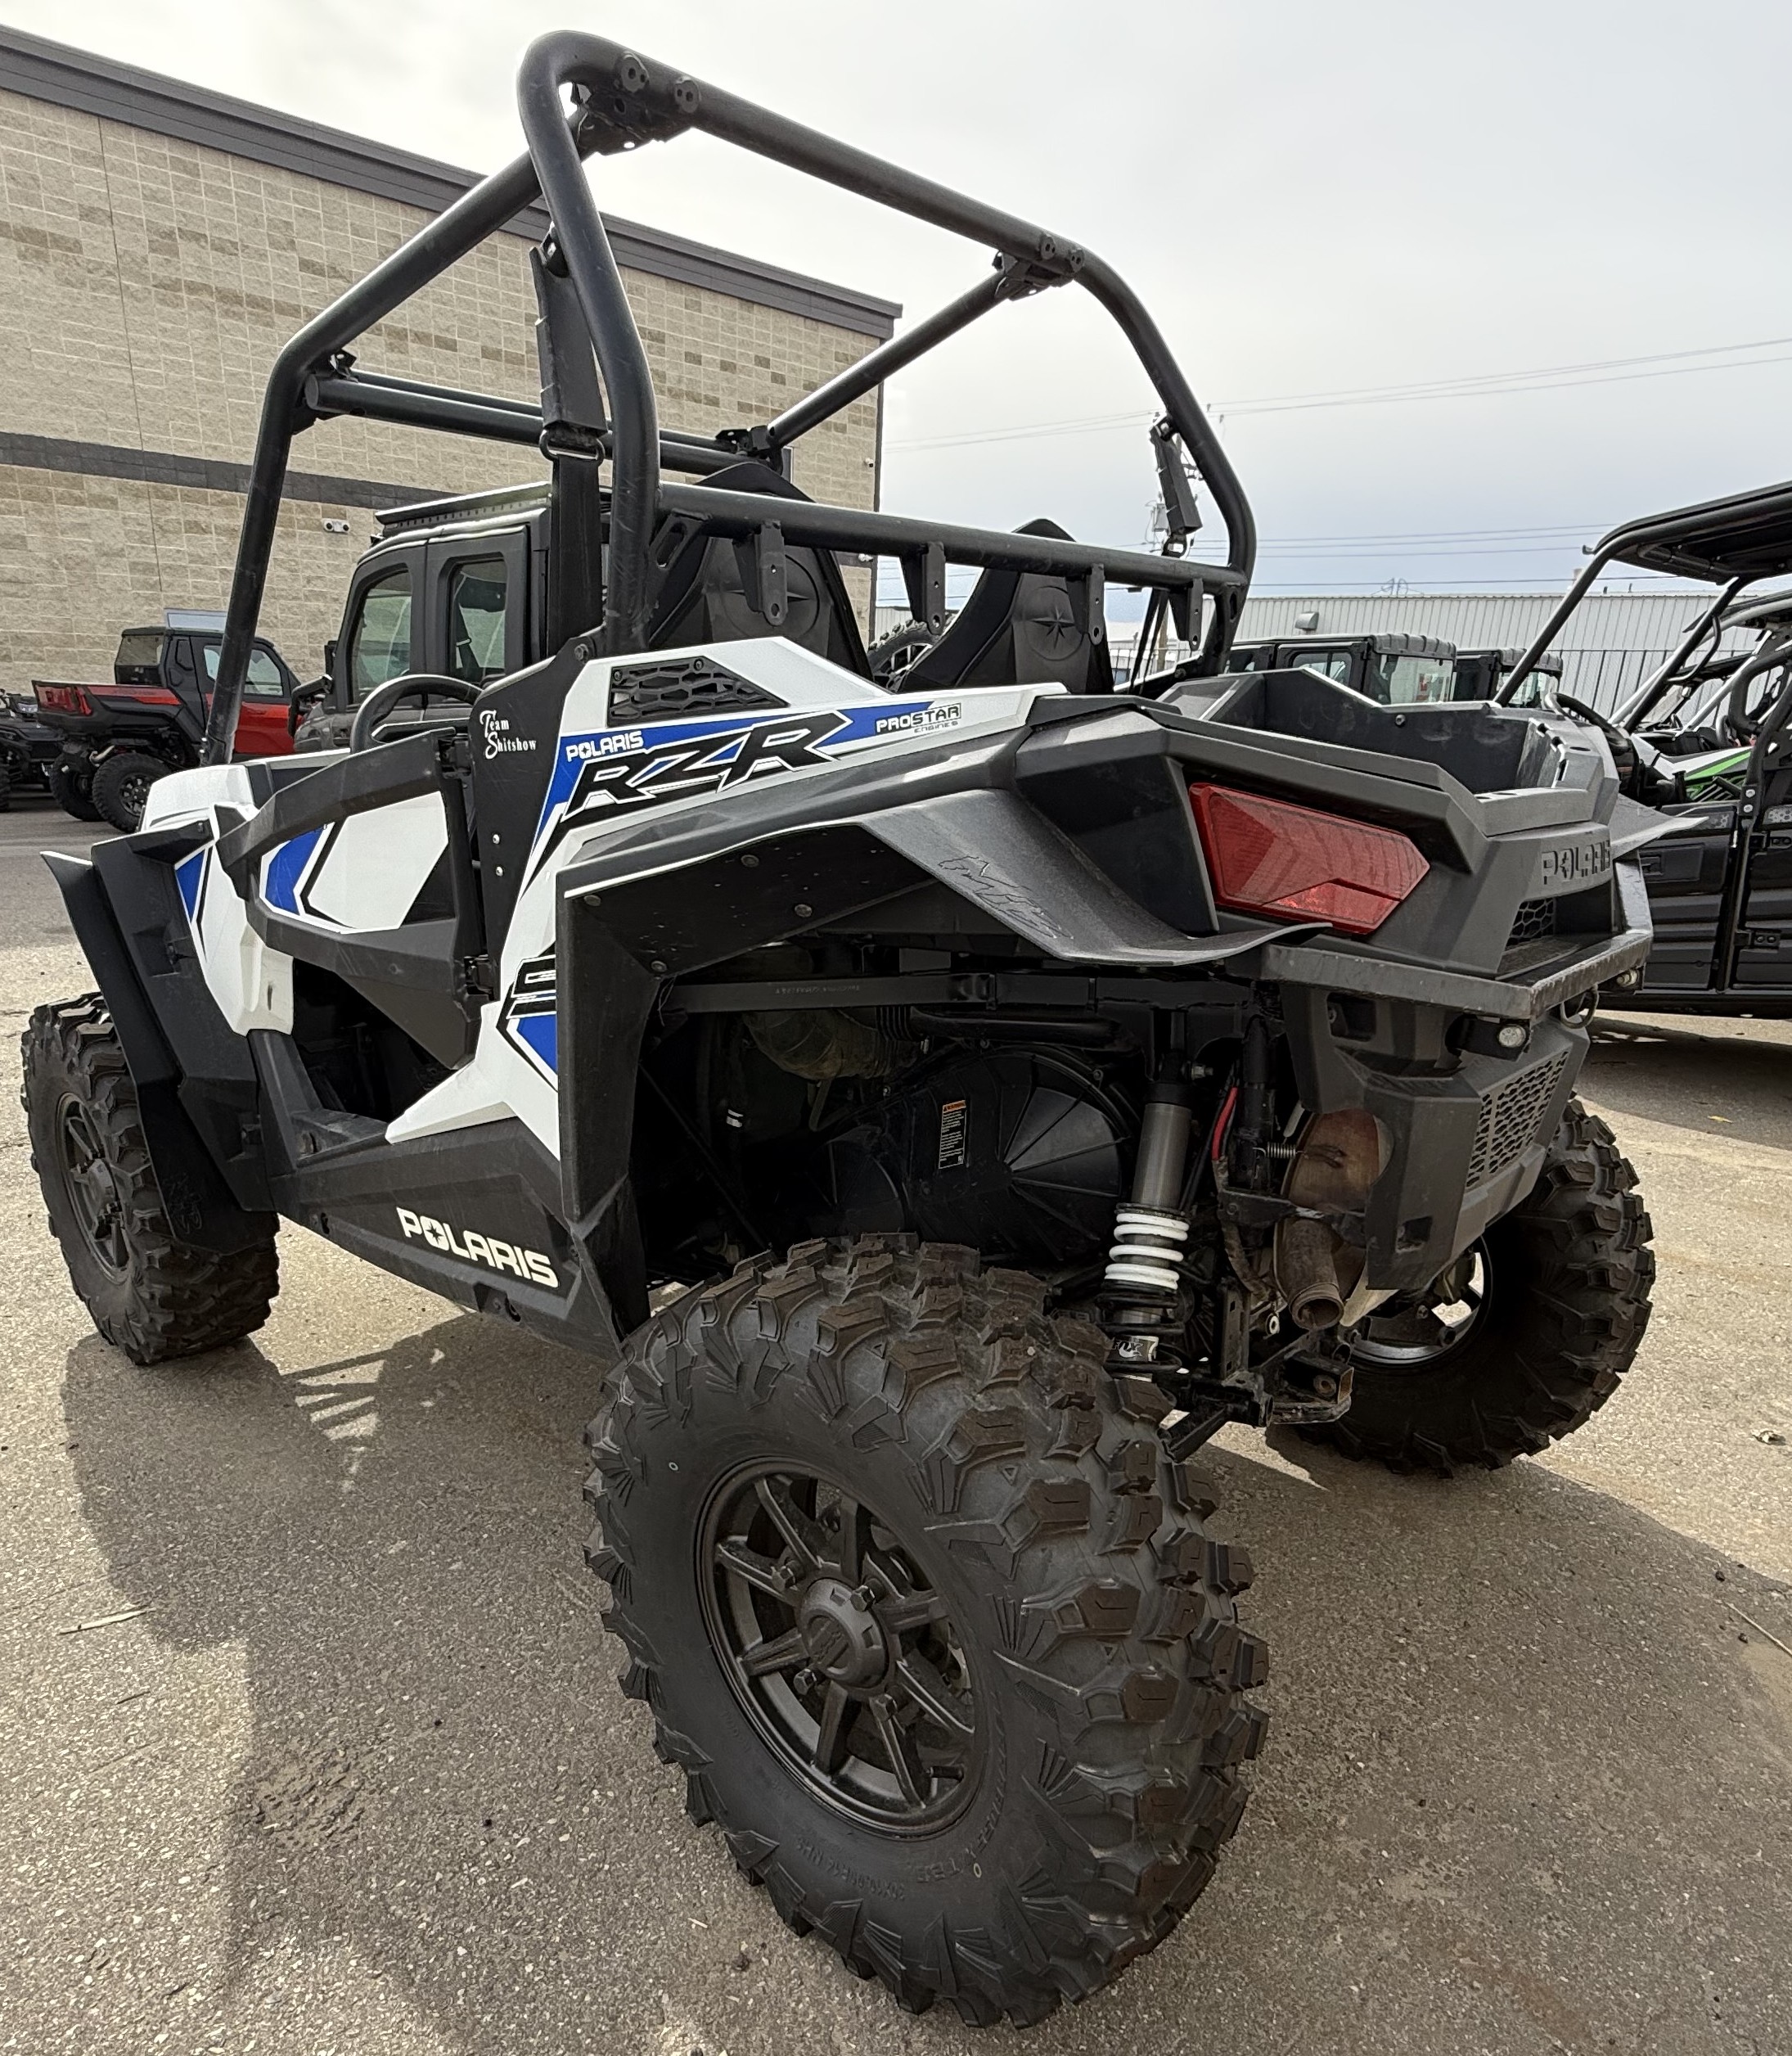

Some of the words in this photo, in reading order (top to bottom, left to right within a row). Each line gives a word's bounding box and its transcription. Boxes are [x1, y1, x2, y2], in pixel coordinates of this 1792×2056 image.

[480, 710, 510, 738] Team
[876, 705, 960, 733] PROSTAR
[485, 731, 537, 760] Shitshow
[565, 731, 645, 763] POLARIS
[561, 710, 853, 823] RZR
[396, 1206, 561, 1288] POLARIS
